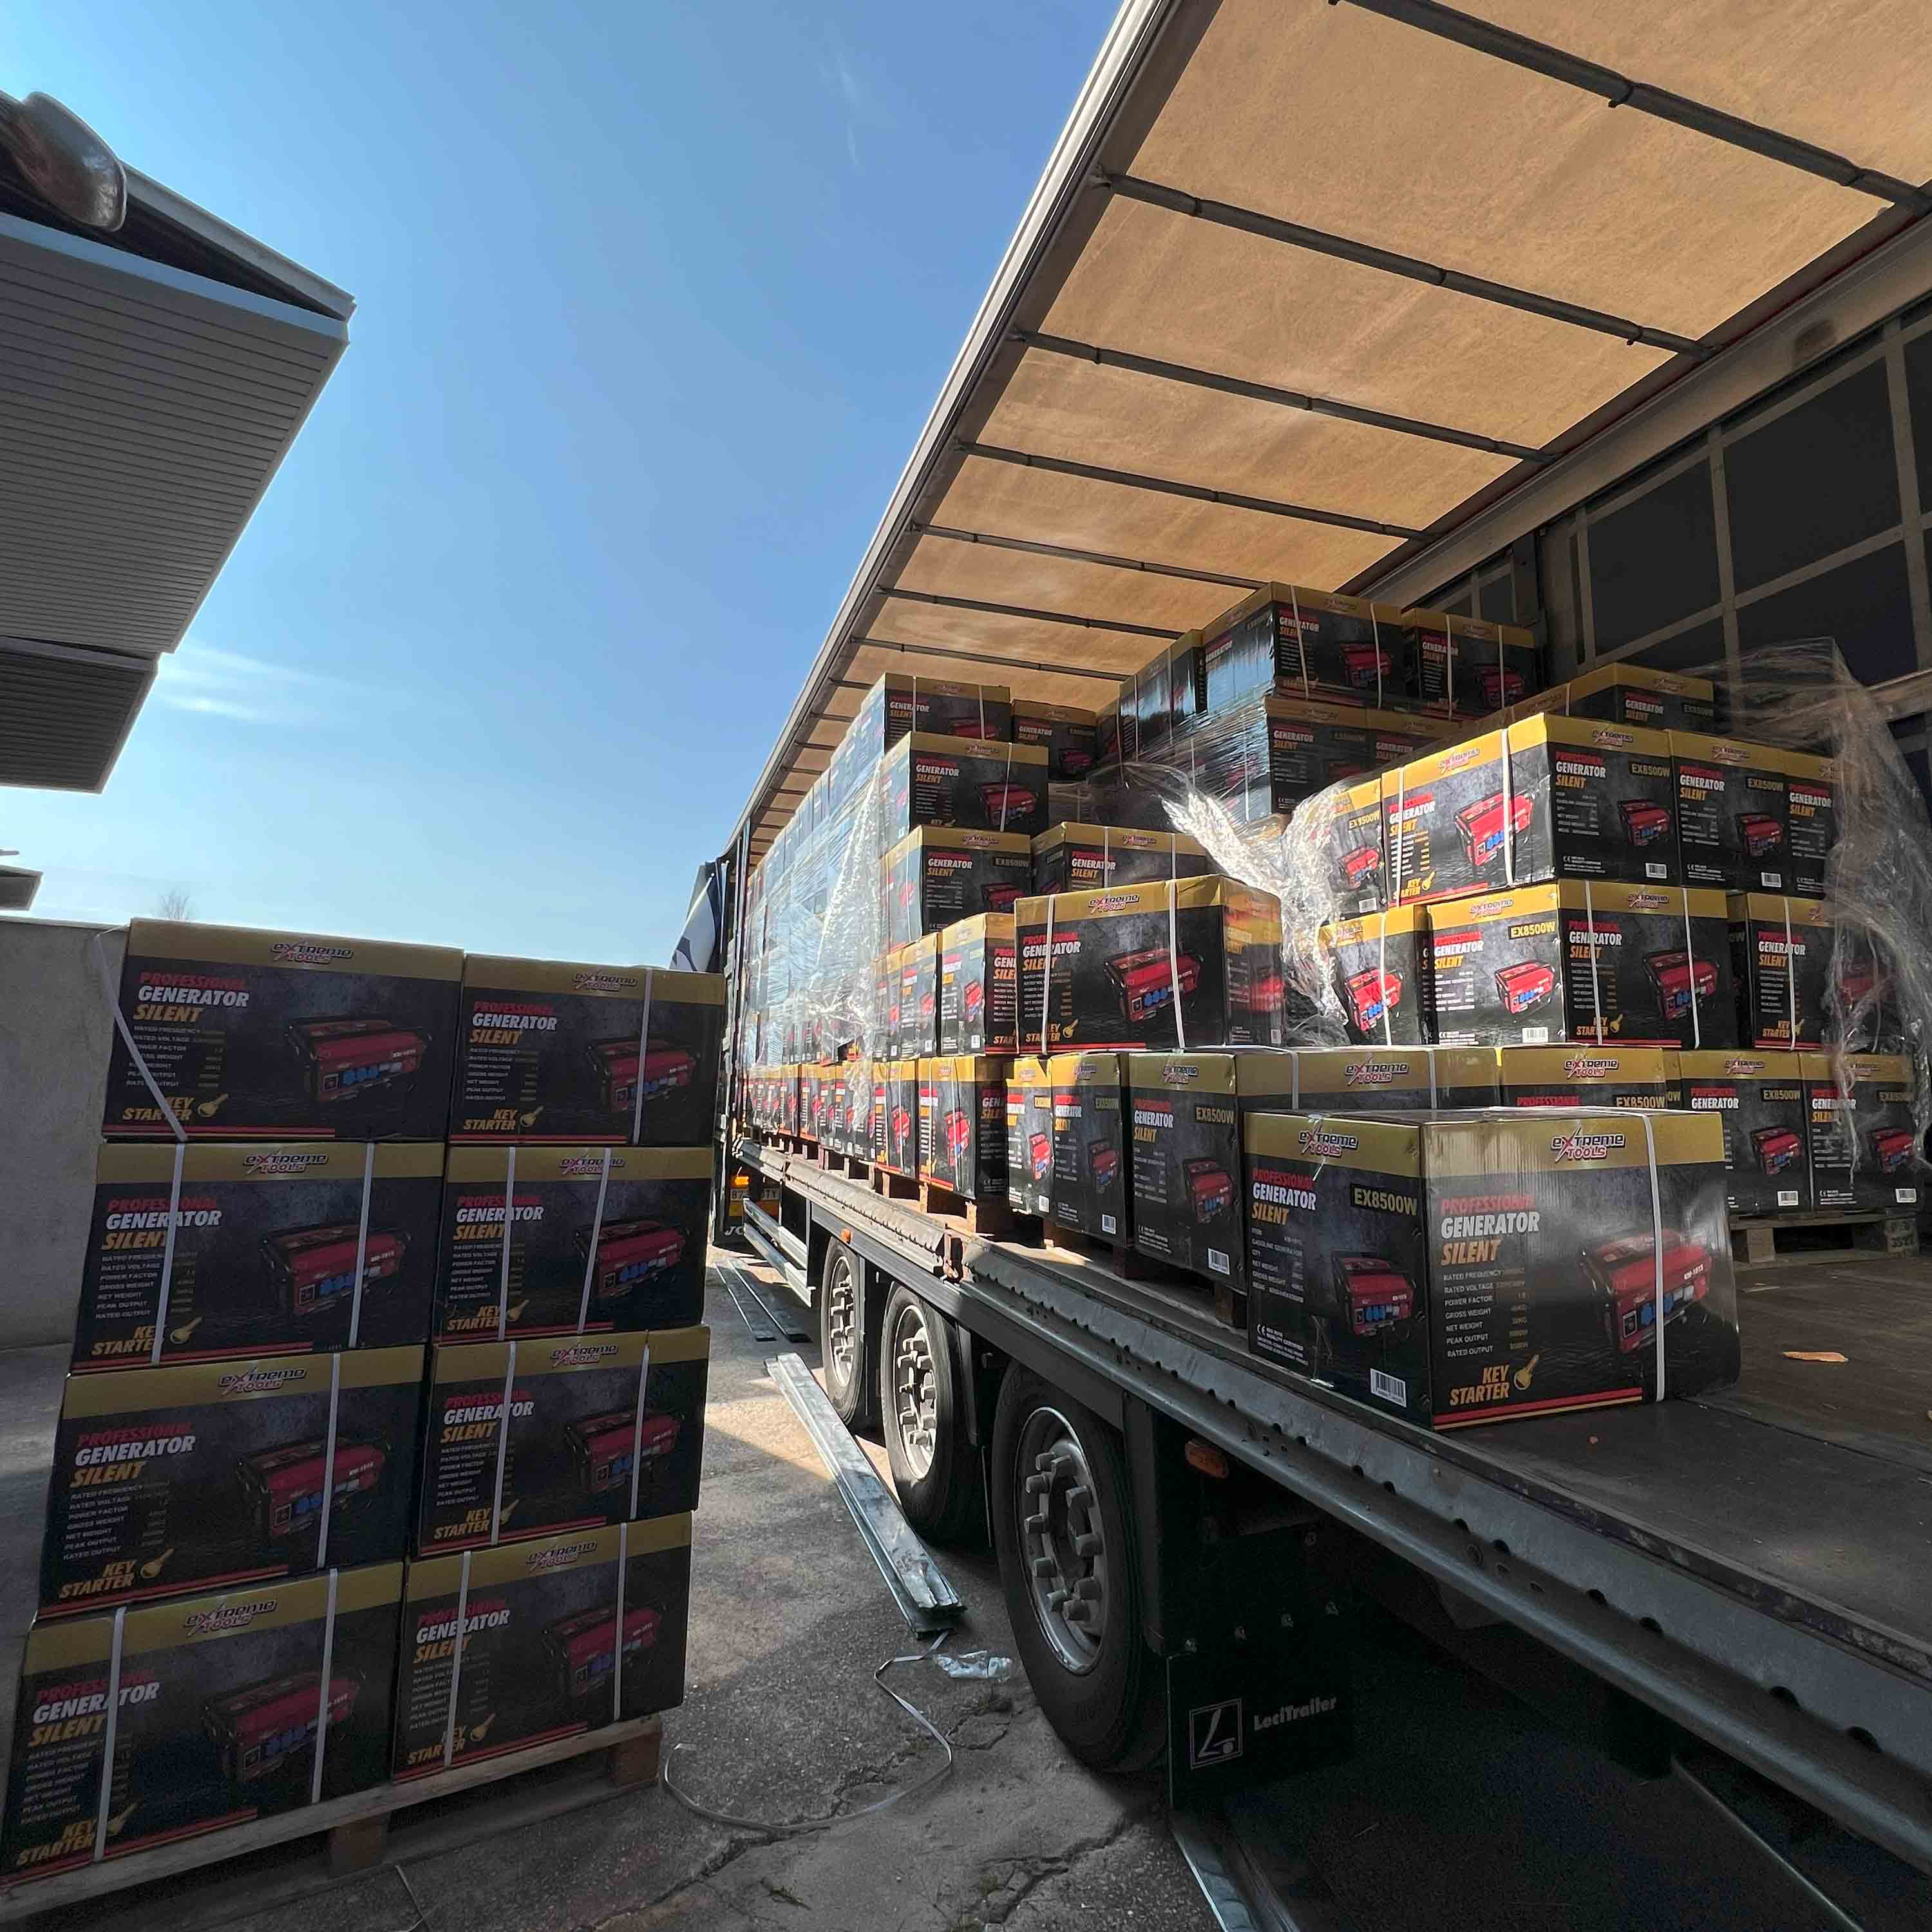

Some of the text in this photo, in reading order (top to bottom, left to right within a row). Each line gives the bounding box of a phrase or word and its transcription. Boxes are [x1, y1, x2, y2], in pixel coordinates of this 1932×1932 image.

[916, 764, 960, 777] GENERATOR
[1555, 761, 1607, 779] GENERATOR
[915, 774, 942, 784] SILENT
[1555, 775, 1587, 789] SILENT
[1680, 775, 1725, 792] GENERATOR
[1680, 787, 1707, 801] SILENT
[1789, 791, 1832, 809] GENERATOR
[927, 858, 974, 870] GENERATOR
[927, 867, 954, 876] SILENT
[1071, 868, 1097, 879] SILENT
[1392, 886, 1422, 900] SARTER
[1510, 921, 1556, 938] EX8500W
[1434, 940, 1484, 958] GENERATOR
[1434, 955, 1464, 970] SILENT
[1758, 954, 1788, 967] SILENT
[138, 985, 251, 1007] GENERATOR
[133, 1004, 204, 1022] SILENT
[472, 1012, 557, 1030] GENERATOR
[469, 1029, 522, 1045] SILENT
[1616, 1097, 1667, 1109] EX8500W
[1691, 1097, 1739, 1110] GENERATOR
[123, 1108, 192, 1121] STARER
[493, 1108, 518, 1120] KEY
[1133, 1109, 1174, 1129] GENERATOR
[1195, 1106, 1235, 1124] EX8500W
[463, 1119, 516, 1130] STARTER
[1133, 1126, 1157, 1144] SILENT
[1566, 1146, 1607, 1160] TOOLS
[1253, 1182, 1317, 1211] GENERATOR
[1354, 1187, 1417, 1217] EX8500W
[1252, 1202, 1289, 1226] SILENT
[1441, 1211, 1540, 1240] GENERATOR
[1441, 1236, 1501, 1266] SILENT
[1443, 1273, 1464, 1281] RATED
[1444, 1282, 1494, 1294] RATED VOLTAGE
[1444, 1295, 1493, 1306] POWER FACTOR
[1445, 1308, 1491, 1320] GROSS WEIGHT
[133, 1325, 169, 1340] KE
[1459, 1321, 1483, 1331] WEIGHT
[92, 1338, 164, 1356] STARTE
[1446, 1333, 1488, 1345] PEAK OUTPUT
[1447, 1345, 1493, 1358] RATED OUTPUT
[1482, 1365, 1510, 1385] KEY
[1449, 1382, 1510, 1406] STARTER
[440, 1421, 497, 1443] SILENT
[74, 1435, 196, 1467] GENERATOR
[70, 1460, 147, 1489] SILENT
[466, 1508, 491, 1522] KEY
[434, 1520, 490, 1540] STARTER
[103, 1560, 137, 1577] KEY
[60, 1575, 136, 1598] STARTER
[28, 1714, 105, 1747] SILENT
